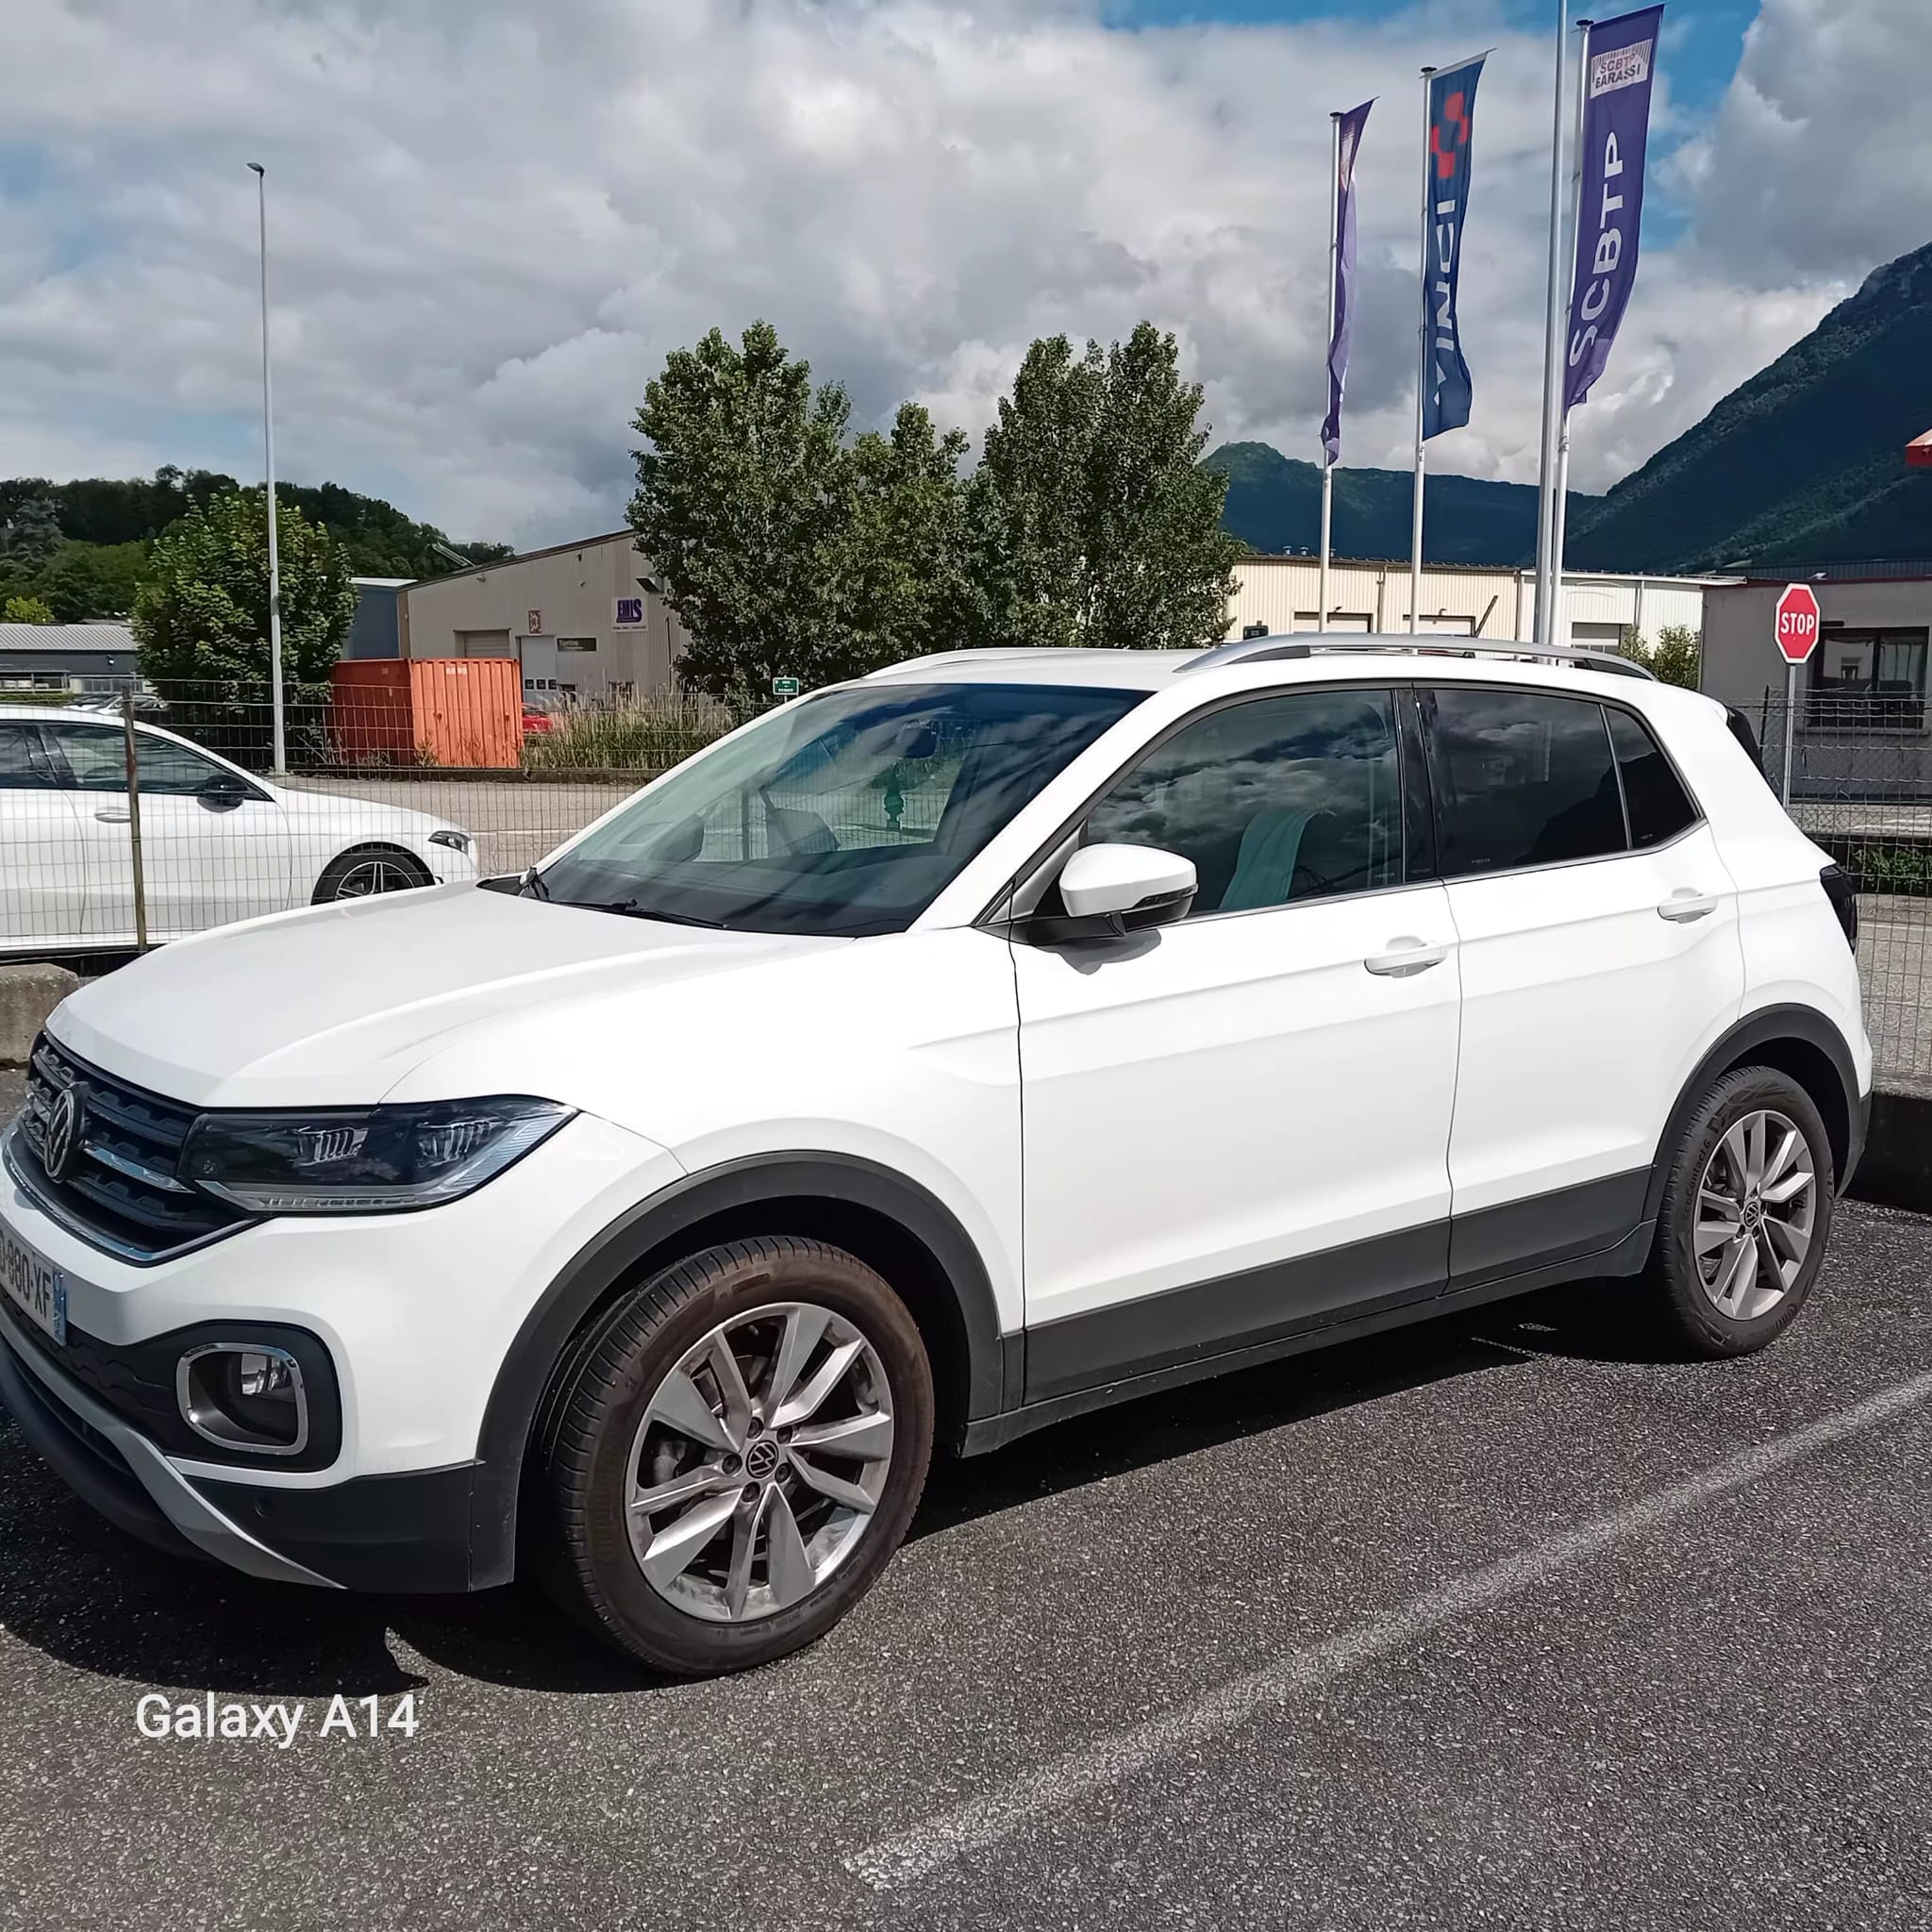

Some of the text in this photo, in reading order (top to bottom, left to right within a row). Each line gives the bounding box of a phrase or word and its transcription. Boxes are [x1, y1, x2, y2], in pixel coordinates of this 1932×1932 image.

[1600, 53, 1635, 75] SCBTP
[1569, 130, 1624, 367] SCBTP
[1780, 611, 1815, 636] STOP
